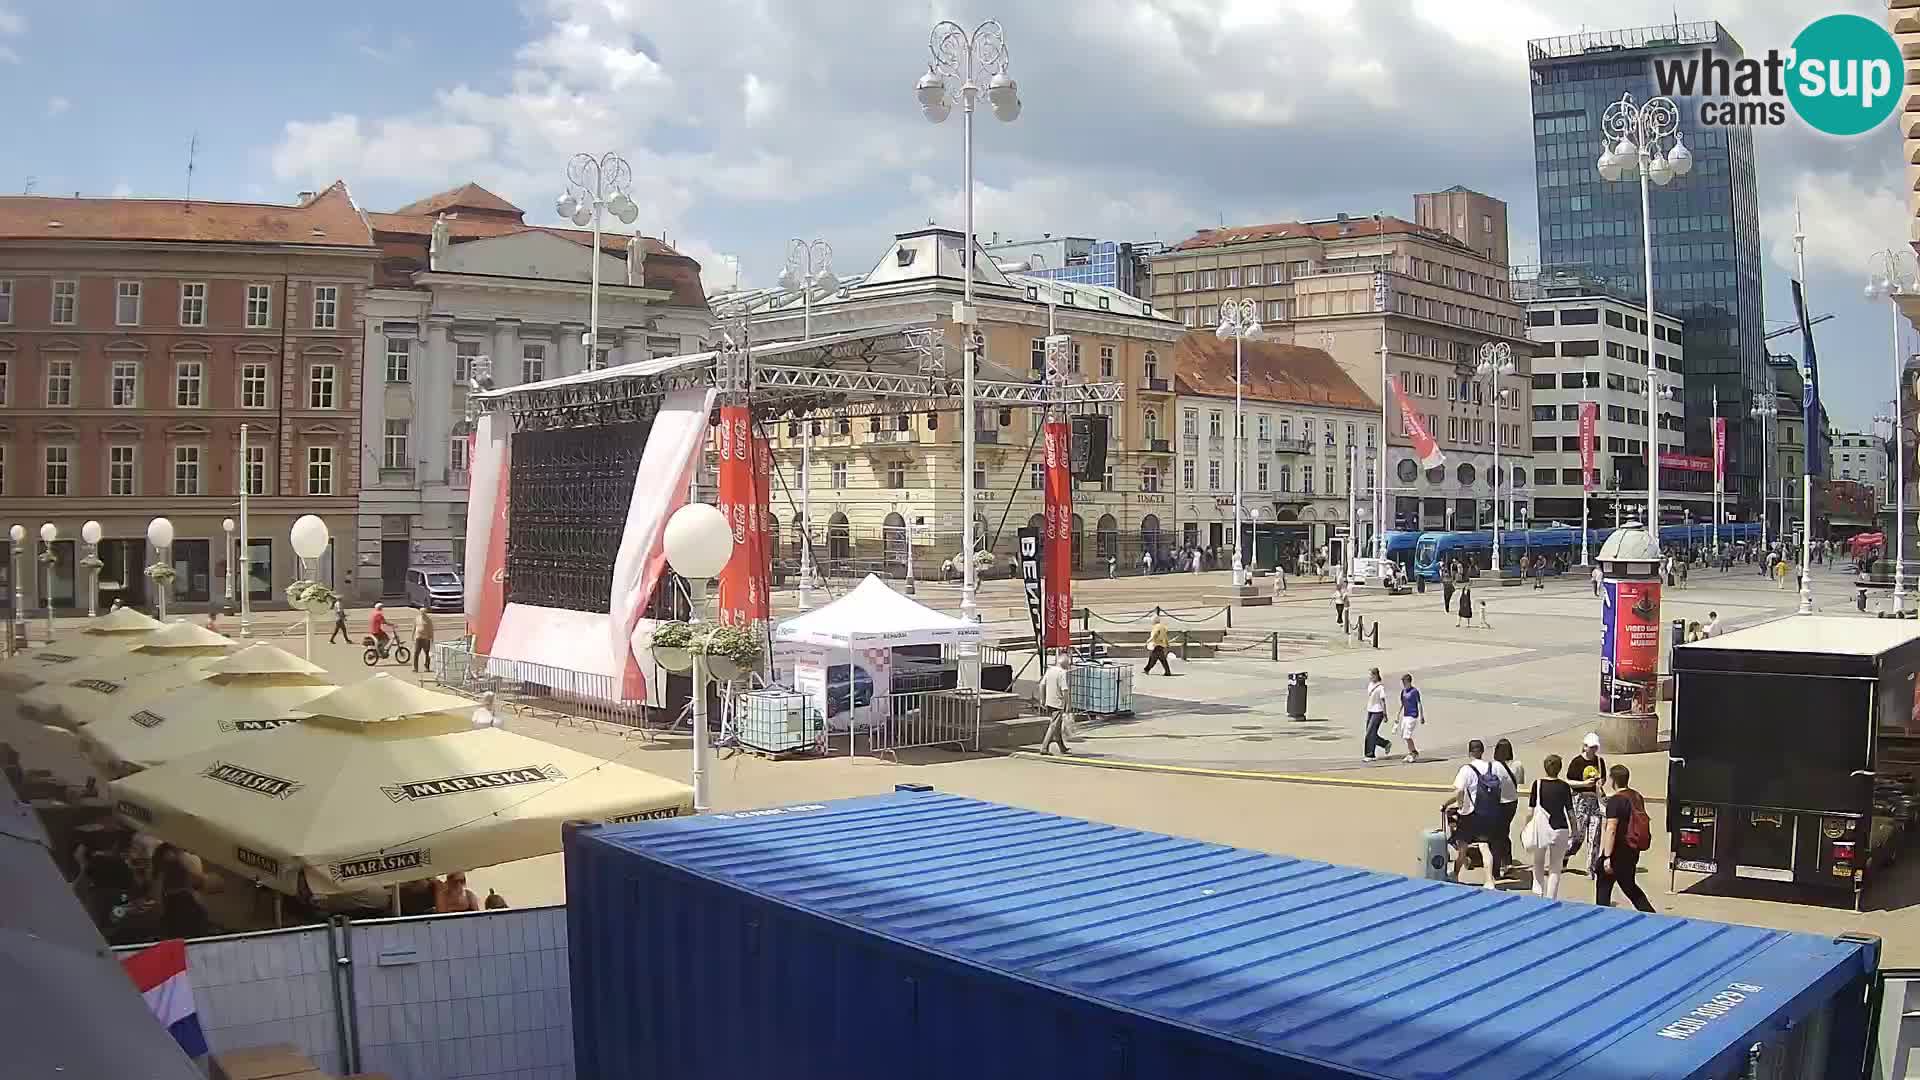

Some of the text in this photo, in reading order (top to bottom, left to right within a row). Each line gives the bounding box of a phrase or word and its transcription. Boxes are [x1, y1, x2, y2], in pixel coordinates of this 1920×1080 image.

[734, 419, 747, 461] Coca-Cola
[1046, 432, 1057, 468] Coca-Cola
[733, 503, 746, 544] Coca-Cola
[1059, 504, 1069, 540] Coca-Cola
[1059, 592, 1069, 629] Coca-Cola
[216, 766, 283, 794] MARASKA
[412, 769, 540, 797] MARASKA
[344, 852, 417, 878] MARASKA
